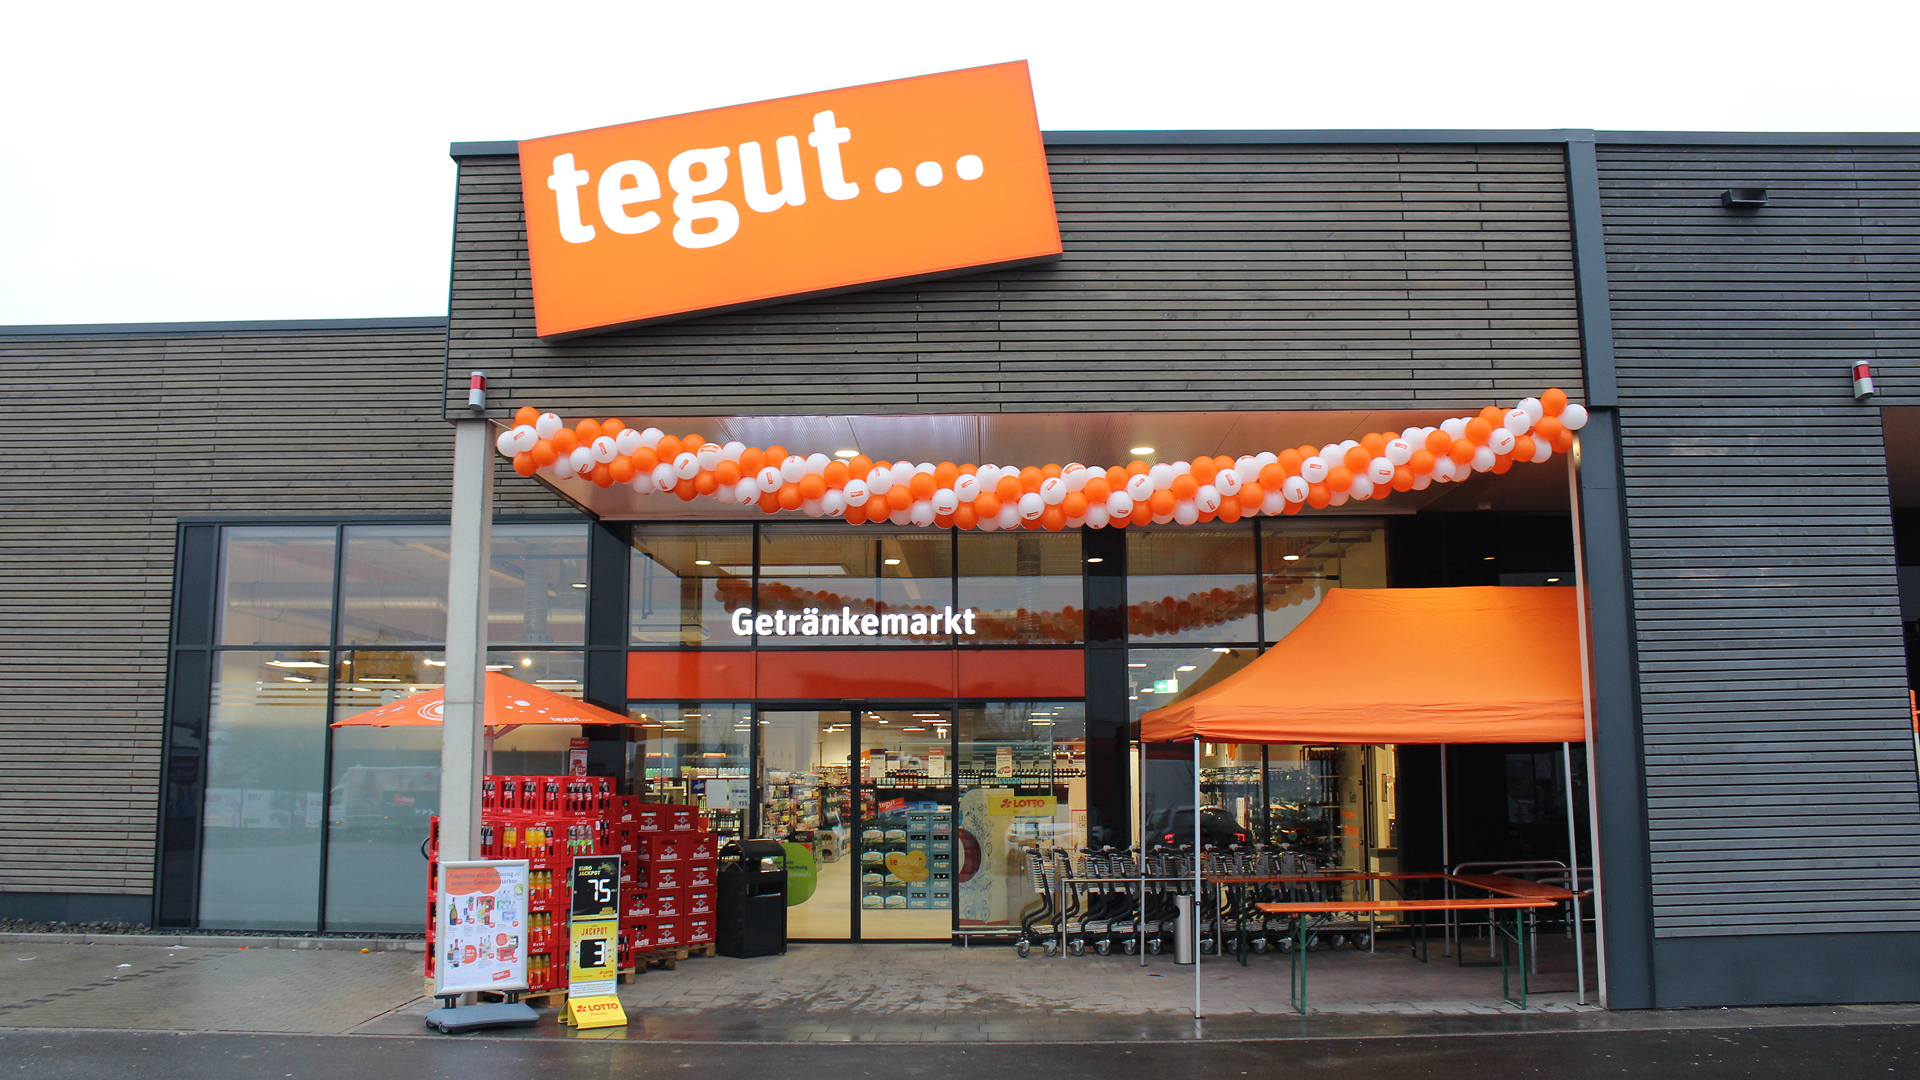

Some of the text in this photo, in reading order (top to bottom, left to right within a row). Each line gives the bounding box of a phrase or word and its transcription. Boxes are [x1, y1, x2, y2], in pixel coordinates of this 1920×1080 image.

[547, 109, 984, 249] tegut...
[731, 605, 976, 636] Getränkemarkt
[1013, 799, 1045, 808] LOTTO
[587, 878, 611, 903] 75
[581, 926, 608, 936] JACKPOT
[593, 941, 605, 966] 3
[588, 1002, 619, 1012] LOTTO
